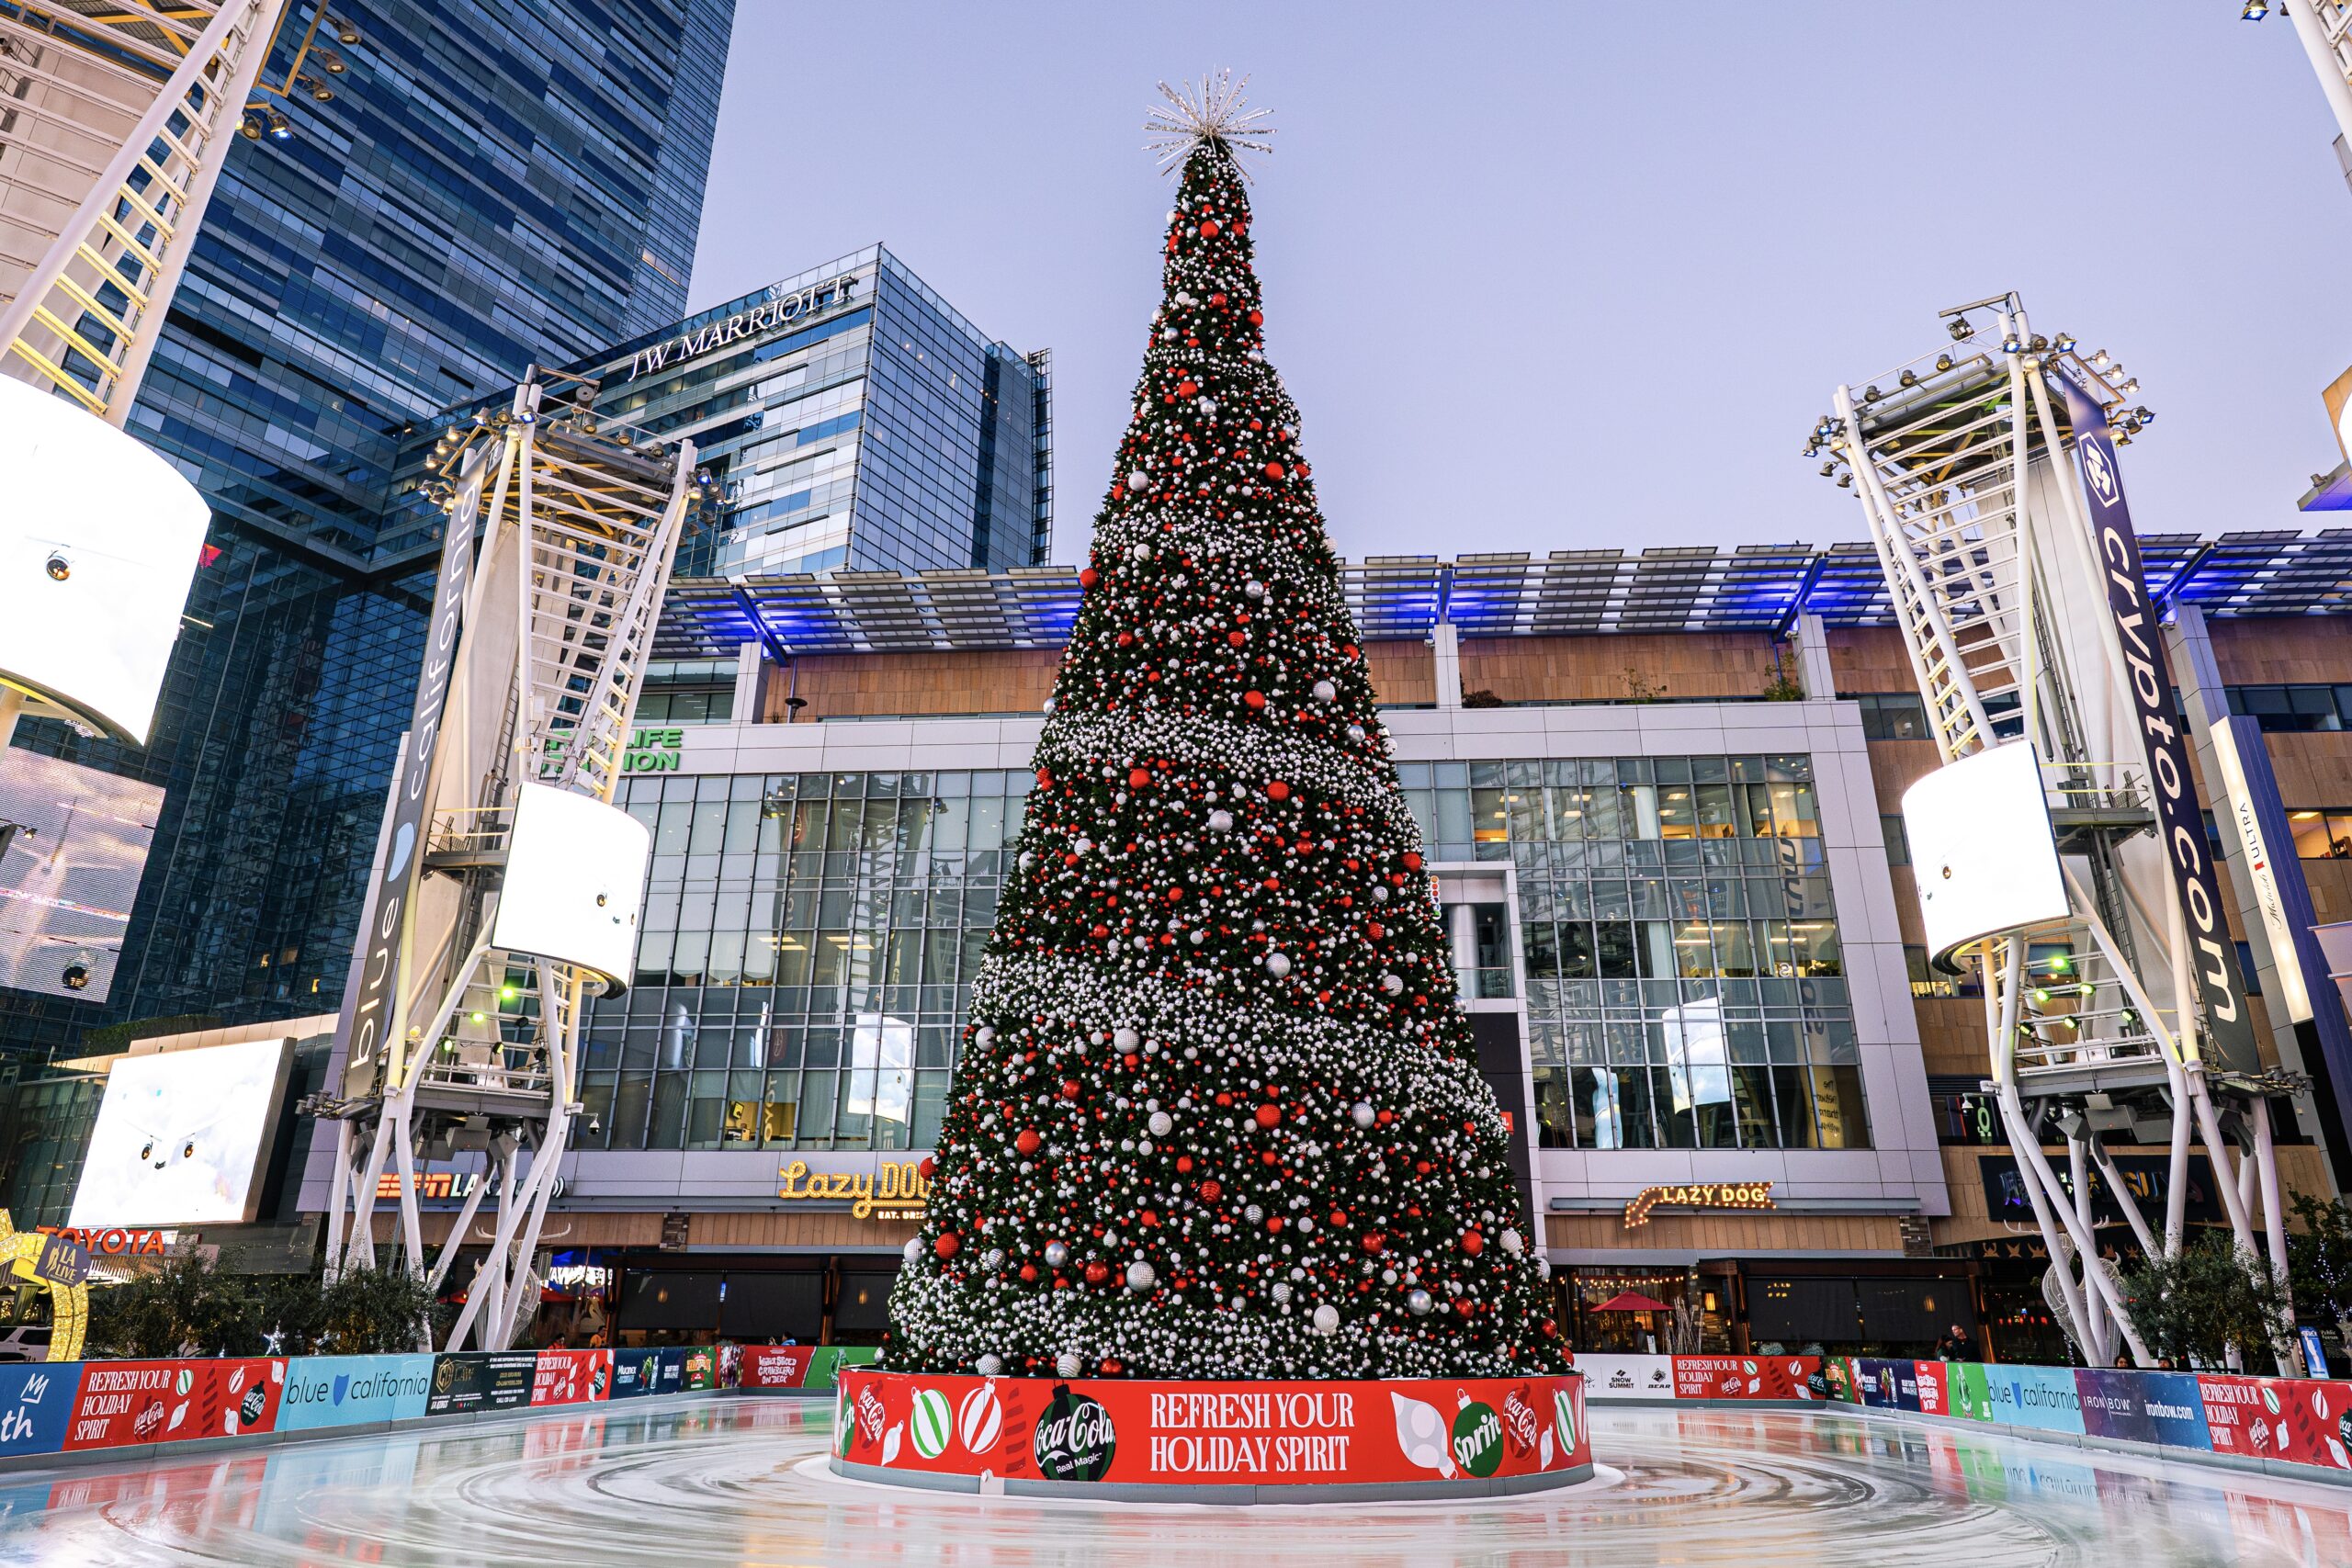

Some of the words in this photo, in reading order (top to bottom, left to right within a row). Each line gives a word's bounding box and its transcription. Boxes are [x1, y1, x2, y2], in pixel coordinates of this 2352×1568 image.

[628, 342, 674, 382] JW
[676, 273, 858, 362] MARRIOTT
[351, 896, 399, 1071] blue
[412, 478, 476, 804] california
[2103, 527, 2238, 1024] crypto.com
[2238, 802, 2261, 860] ULTRA
[779, 1160, 875, 1219] Lazy
[1662, 1188, 1714, 1202] LAZY
[1722, 1188, 1765, 1202] DOG
[37, 1225, 166, 1256] TOYOTA
[60, 1245, 75, 1265] LA
[55, 1264, 77, 1281] LIVE
[758, 1366, 795, 1376] CRANBERRY
[1677, 1359, 1713, 1371] REFRESH
[1713, 1359, 1737, 1371] YOUR
[87, 1370, 139, 1393] REFRESH
[139, 1370, 172, 1390] YOUR
[286, 1376, 329, 1404] blue
[351, 1371, 428, 1400] california
[772, 1375, 787, 1383] DECK
[1679, 1371, 1713, 1382] HOLIDAY
[1679, 1383, 1702, 1394] SPIRIT
[1986, 1379, 2012, 1404] blue
[2023, 1382, 2081, 1411] california
[2199, 1382, 2233, 1404] REFRESH
[2233, 1384, 2260, 1405] YOUR
[81, 1394, 133, 1416] HOLIDAY
[1150, 1393, 1272, 1428] REFRESH
[1275, 1393, 1355, 1428] YOUR
[2083, 1395, 2106, 1409] IRON
[2108, 1397, 2132, 1411] BOW
[2143, 1399, 2194, 1421] ironbow.com
[2205, 1404, 2240, 1425] HOLIDAY
[74, 1419, 109, 1441] SPIRIT
[1034, 1402, 1116, 1462] Coca-Cola
[2210, 1426, 2233, 1446] SPIRIT
[1150, 1436, 1272, 1472] HOLIDAY
[1275, 1435, 1350, 1472] SPIRIT
[1056, 1461, 1074, 1474] Real
